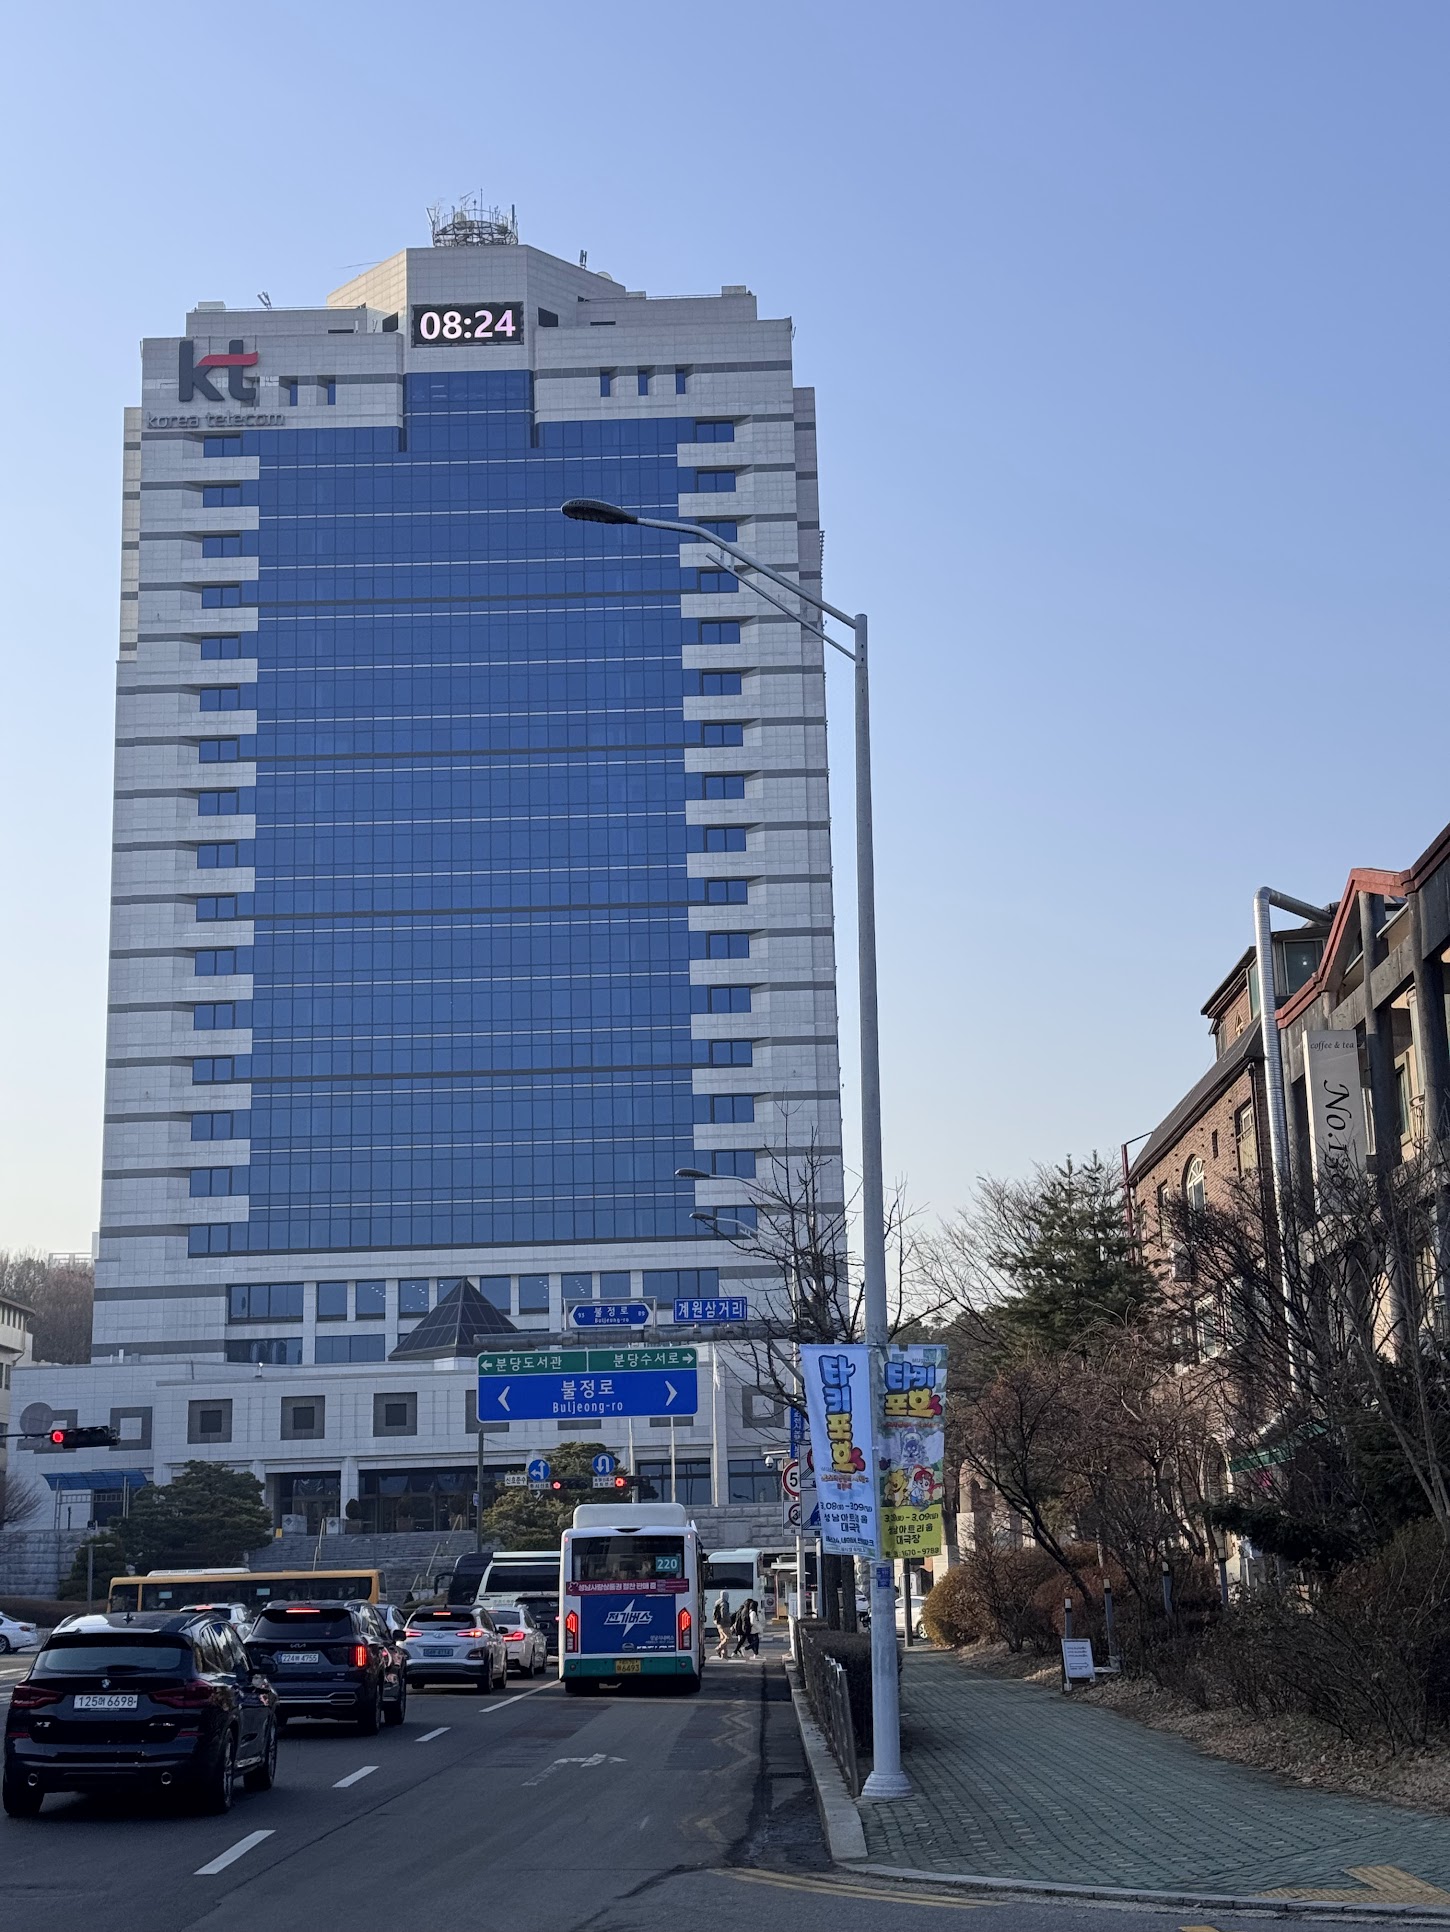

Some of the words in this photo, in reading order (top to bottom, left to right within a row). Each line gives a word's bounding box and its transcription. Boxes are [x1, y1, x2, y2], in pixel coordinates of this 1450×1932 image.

[419, 309, 516, 341] 08:24
[178, 340, 259, 402] kt
[147, 412, 200, 430] korea
[205, 412, 286, 427] telecom
[1310, 1040, 1332, 1052] coffee
[594, 1306, 629, 1318] 불정로
[678, 1300, 744, 1318] 계원삼거리
[496, 1356, 563, 1372] 분당도서관
[613, 1352, 680, 1368] 분당수서로
[560, 1379, 614, 1400] 불정로
[552, 1400, 624, 1414] Buljeong-ro
[896, 1534, 921, 1544] 대극장
[657, 1558, 678, 1570] 220
[604, 1612, 652, 1625] 전기버스
[107, 1696, 134, 1706] 6698
